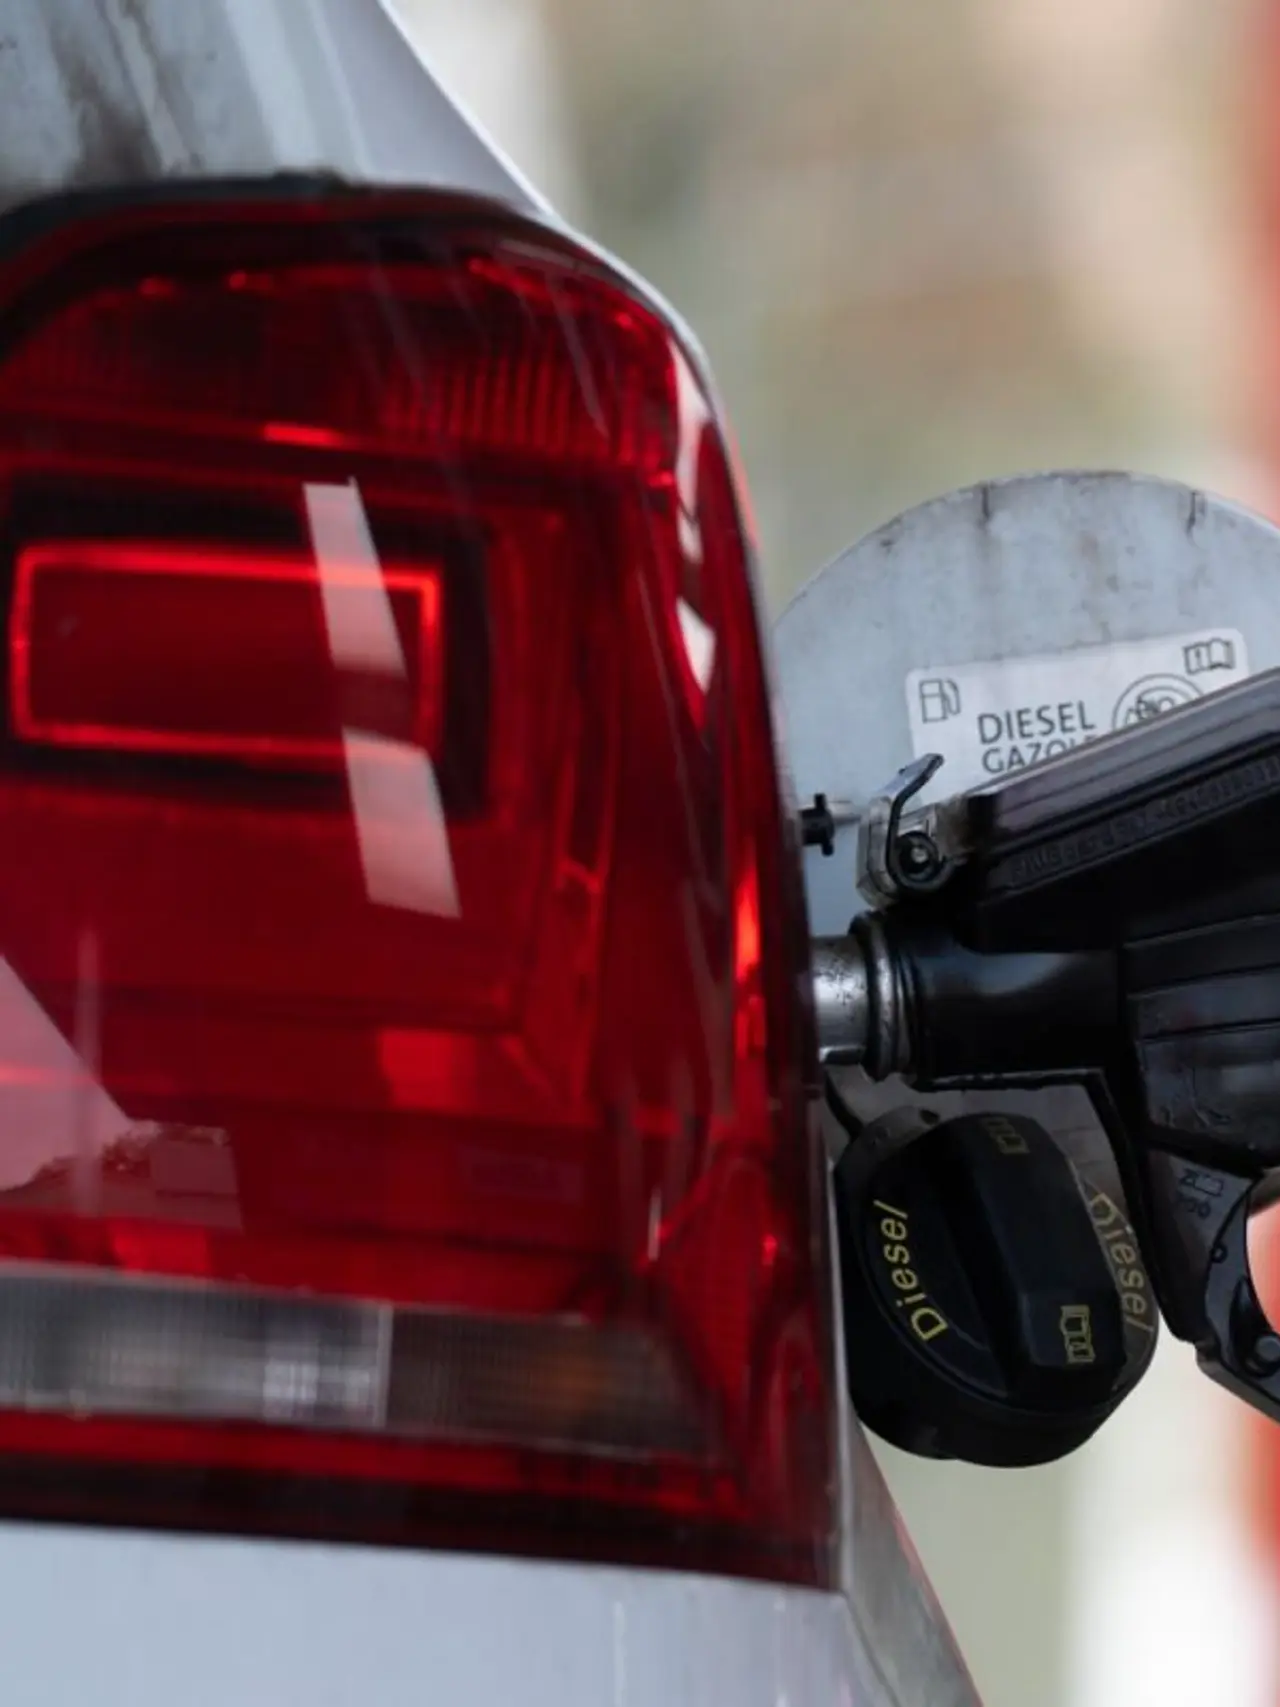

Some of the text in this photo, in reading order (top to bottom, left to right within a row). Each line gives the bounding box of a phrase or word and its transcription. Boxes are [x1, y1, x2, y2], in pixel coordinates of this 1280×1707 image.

[977, 699, 1097, 745] DIESEL
[981, 734, 1097, 774] GAZO
[873, 1199, 949, 1341] Diesel
